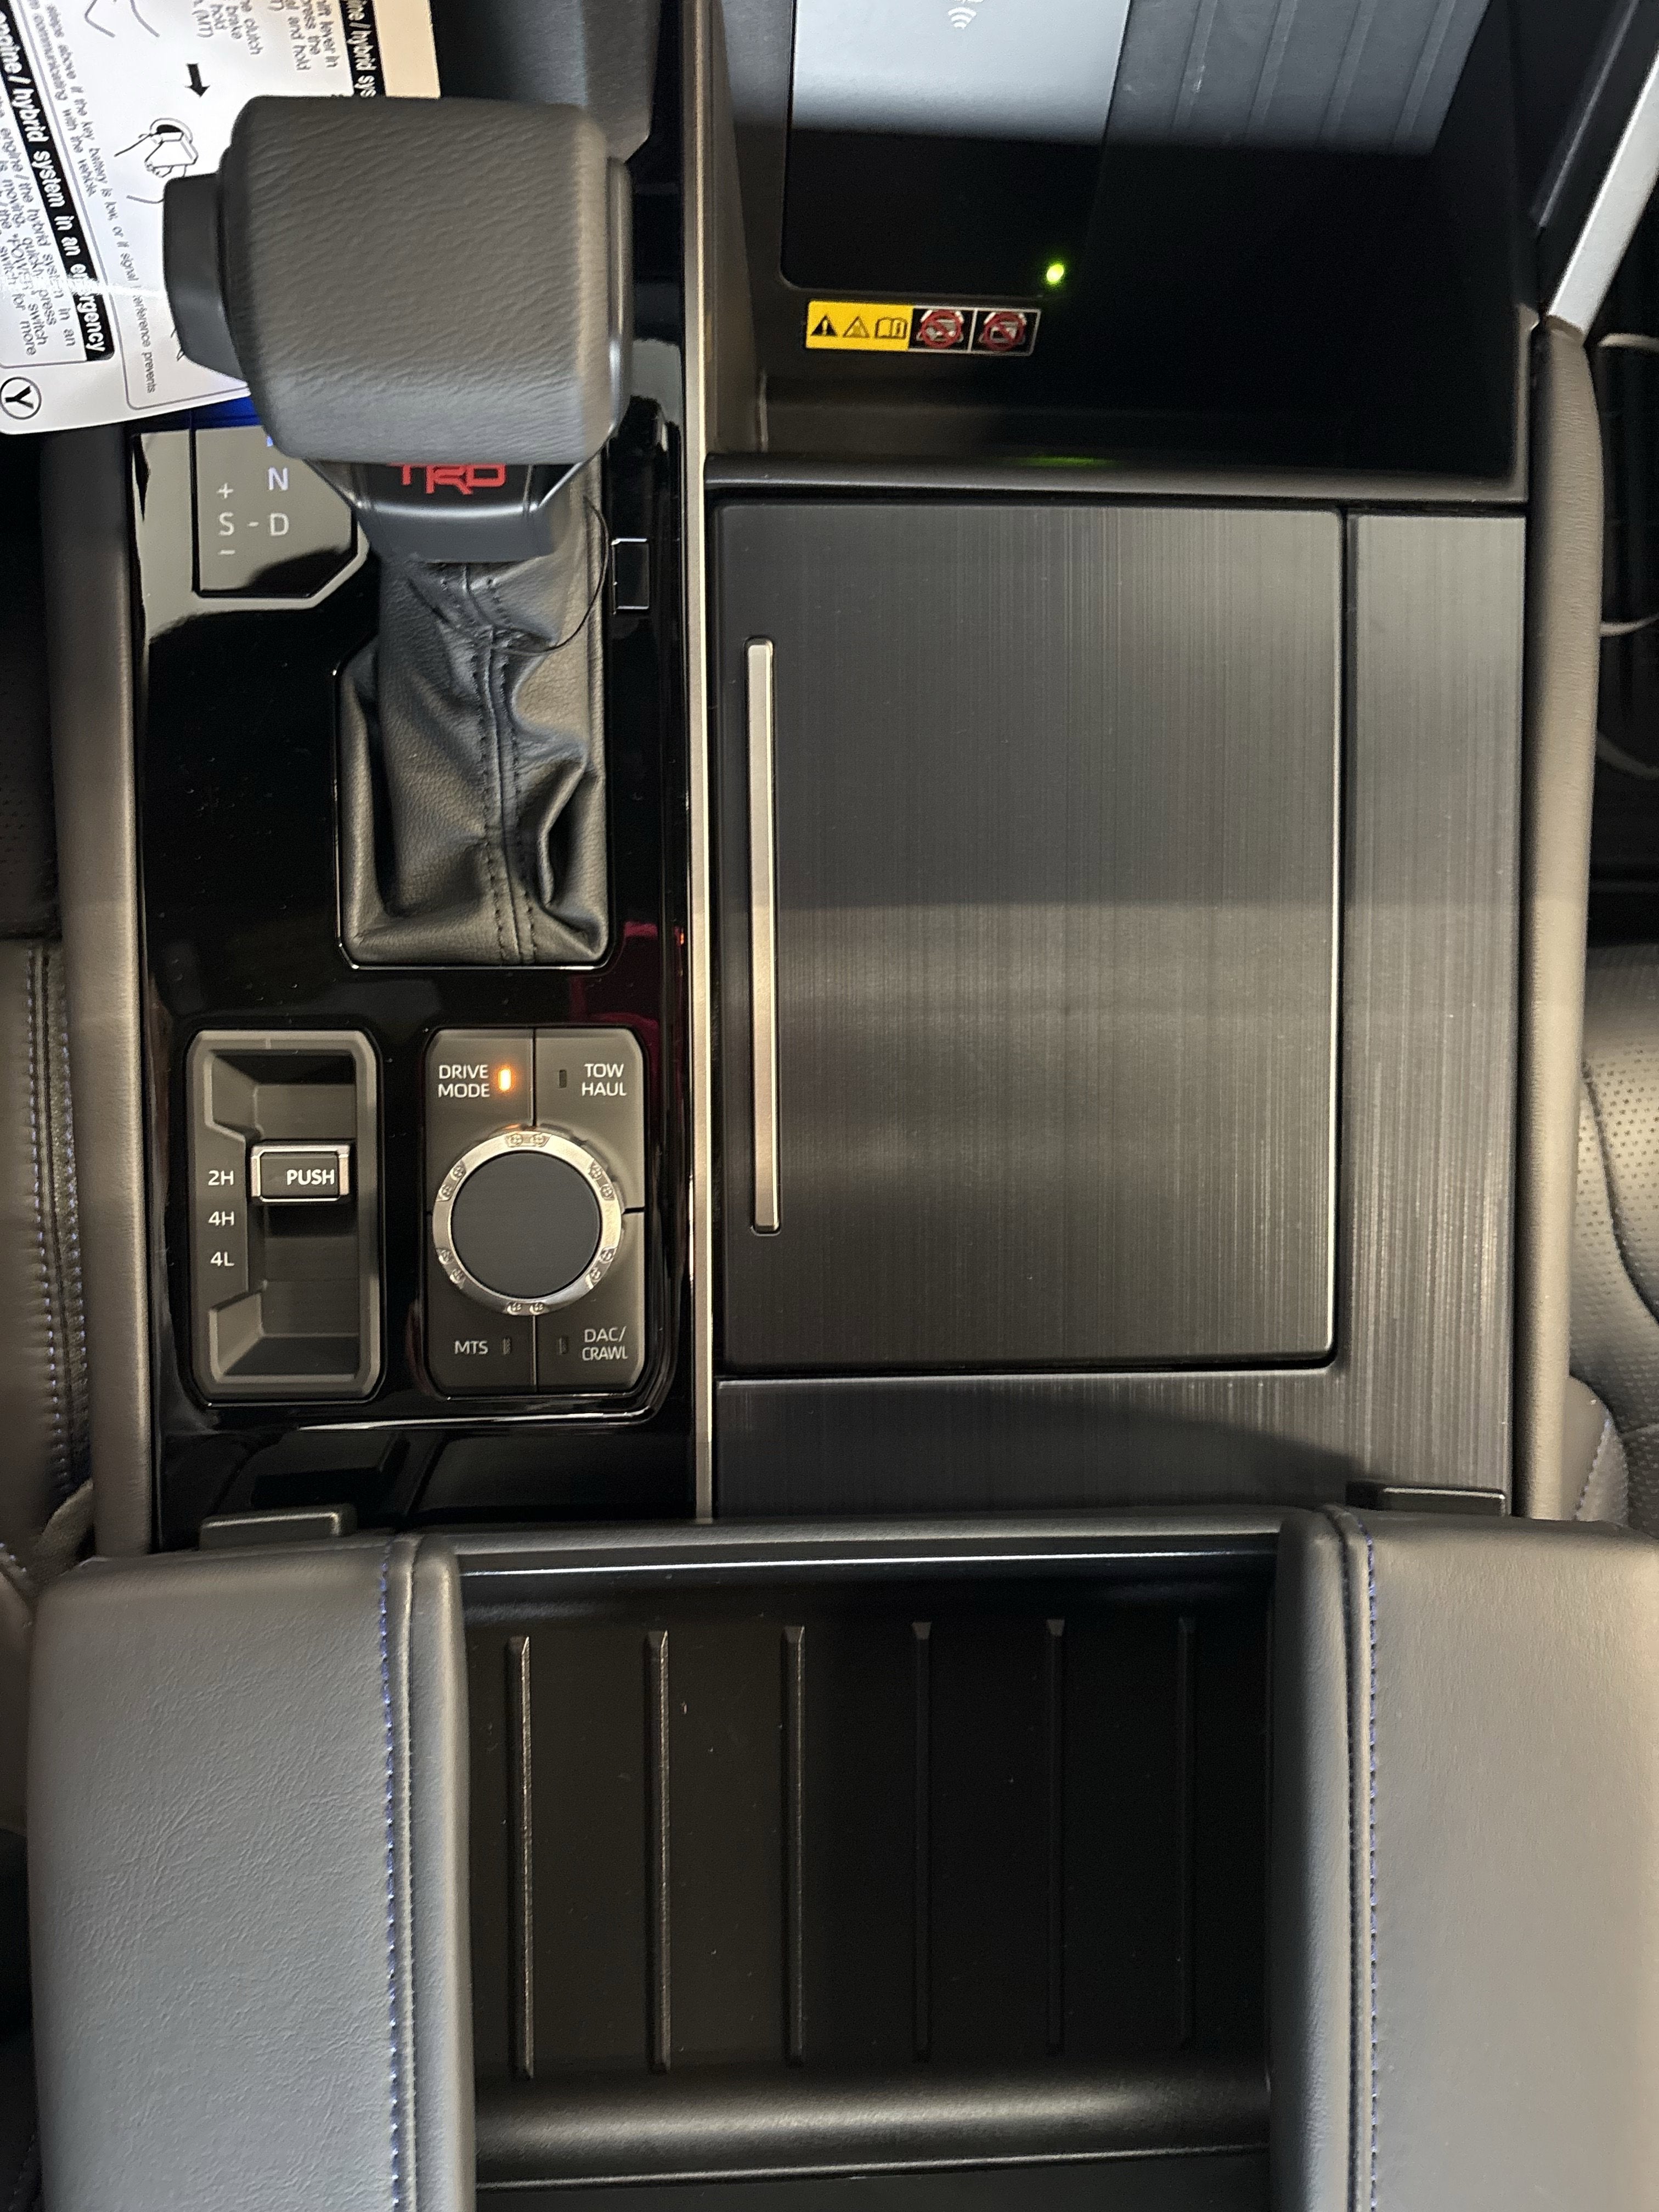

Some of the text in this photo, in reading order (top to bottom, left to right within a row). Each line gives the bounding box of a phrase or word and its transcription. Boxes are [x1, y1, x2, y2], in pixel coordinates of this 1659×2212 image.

[354, 75, 375, 97] sys
[31, 150, 66, 207] system
[54, 215, 75, 230] in
[61, 236, 81, 256] an
[31, 289, 57, 325] press
[58, 308, 71, 320] in
[12, 293, 26, 311] for
[19, 320, 37, 356] more
[27, 303, 48, 345] switch
[63, 329, 76, 346] an
[141, 351, 156, 393] prevents
[5, 385, 34, 409] Y
[268, 467, 289, 491] N
[219, 512, 235, 536] S
[270, 512, 290, 536] D
[438, 1065, 489, 1080] DRIVE
[584, 1063, 625, 1078] TOW
[437, 1083, 491, 1098] MODE
[581, 1081, 628, 1097] HAUL
[208, 1170, 235, 1186] 2H
[286, 1169, 336, 1186] PUSH
[207, 1211, 235, 1227] 4H
[210, 1251, 235, 1267] 4L
[583, 1328, 627, 1344] DAC/
[454, 1340, 489, 1355] MTS
[582, 1346, 629, 1361] CRAWL
